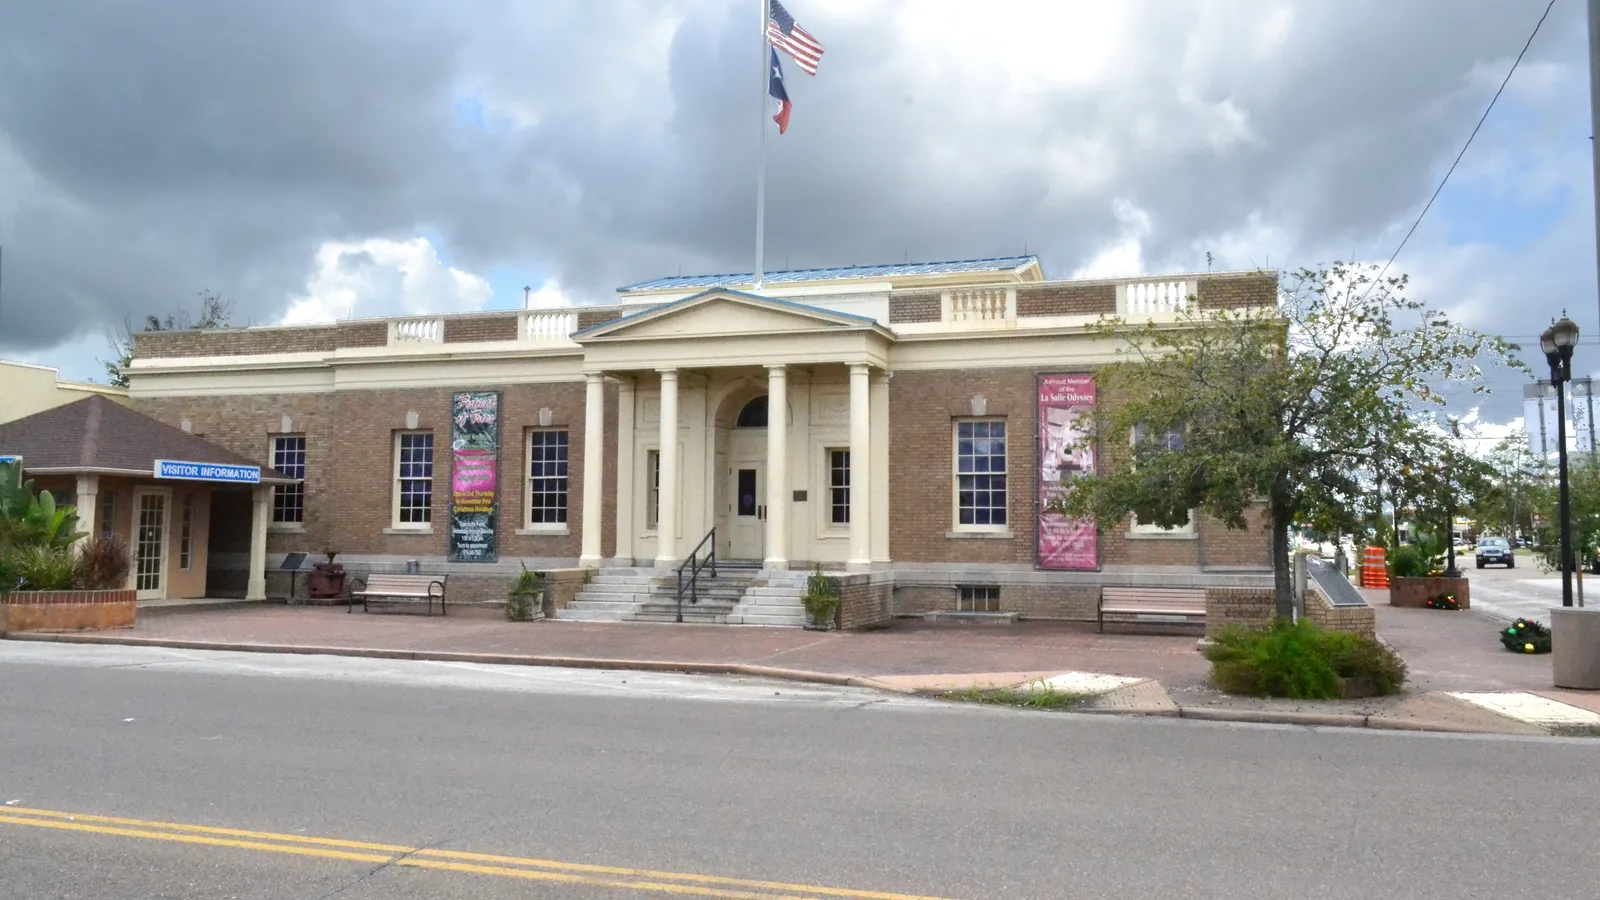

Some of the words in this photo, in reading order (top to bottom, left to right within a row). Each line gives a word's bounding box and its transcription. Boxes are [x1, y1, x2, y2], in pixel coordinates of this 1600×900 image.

[1041, 393, 1049, 402] La
[1050, 393, 1066, 402] Salle
[1067, 393, 1094, 403] Odyssey
[162, 464, 199, 476] VISITOR
[201, 467, 259, 479] INFORMATION
